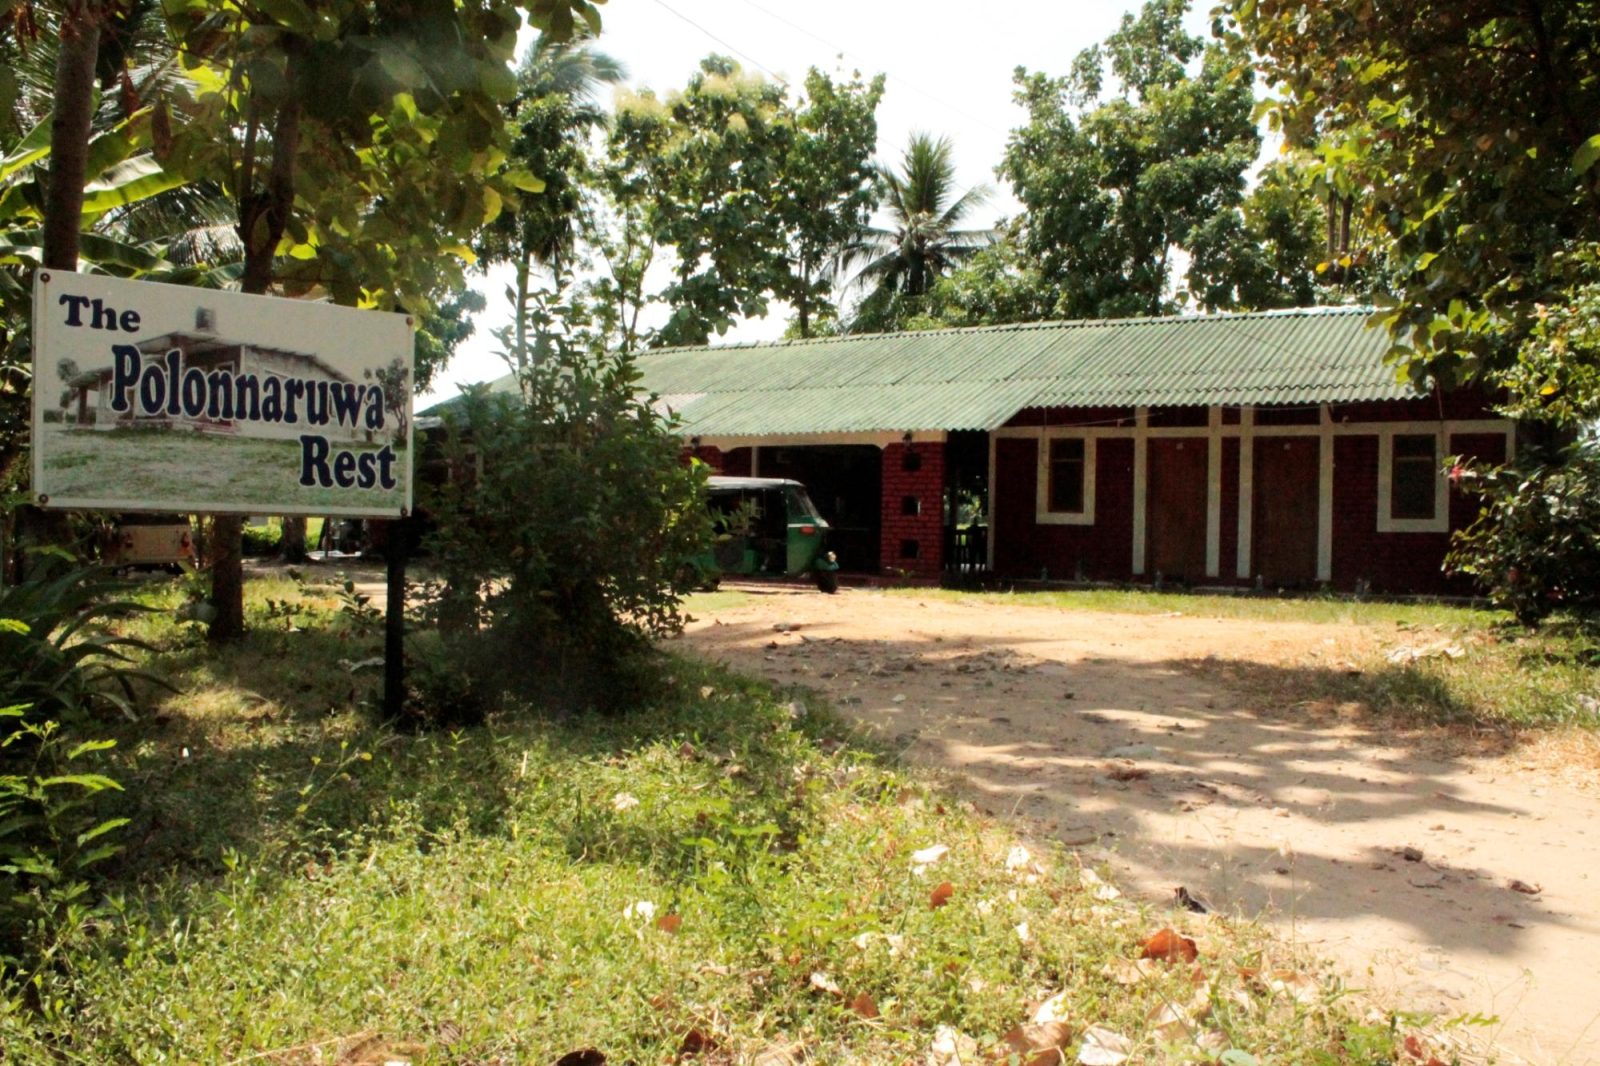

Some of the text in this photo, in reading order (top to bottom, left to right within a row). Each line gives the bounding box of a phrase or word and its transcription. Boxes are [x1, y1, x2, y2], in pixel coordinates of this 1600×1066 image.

[59, 294, 141, 333] The
[111, 344, 385, 431] Polonnaruwa
[299, 434, 397, 490] Rest
